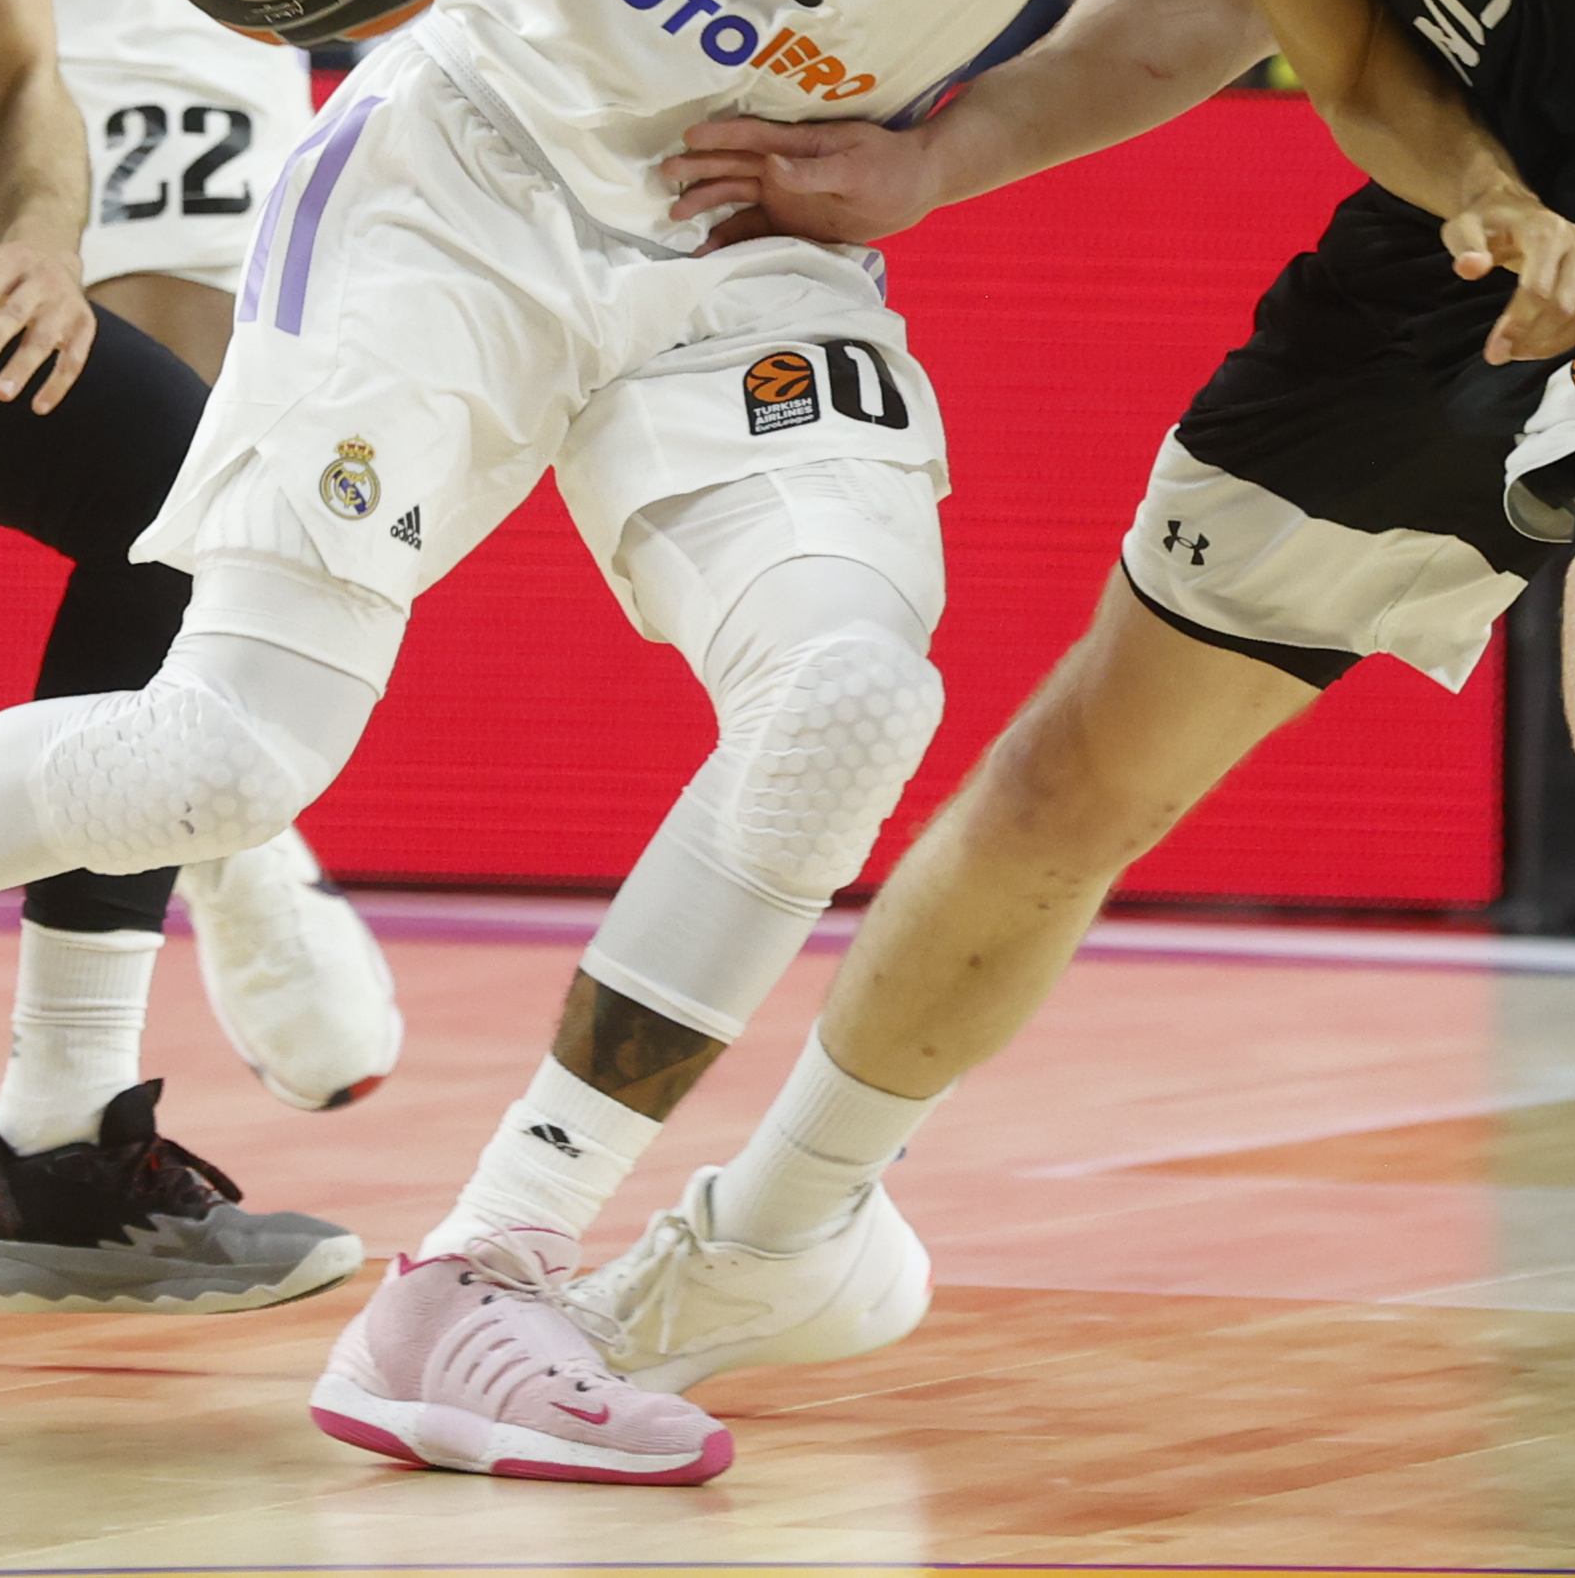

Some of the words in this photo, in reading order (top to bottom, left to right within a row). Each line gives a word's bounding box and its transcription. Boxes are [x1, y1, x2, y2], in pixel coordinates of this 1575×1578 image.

[100, 104, 253, 227] 22
[754, 396, 813, 416] TURKISH
[755, 405, 815, 426] AIRLINES
[390, 525, 422, 551] adida
